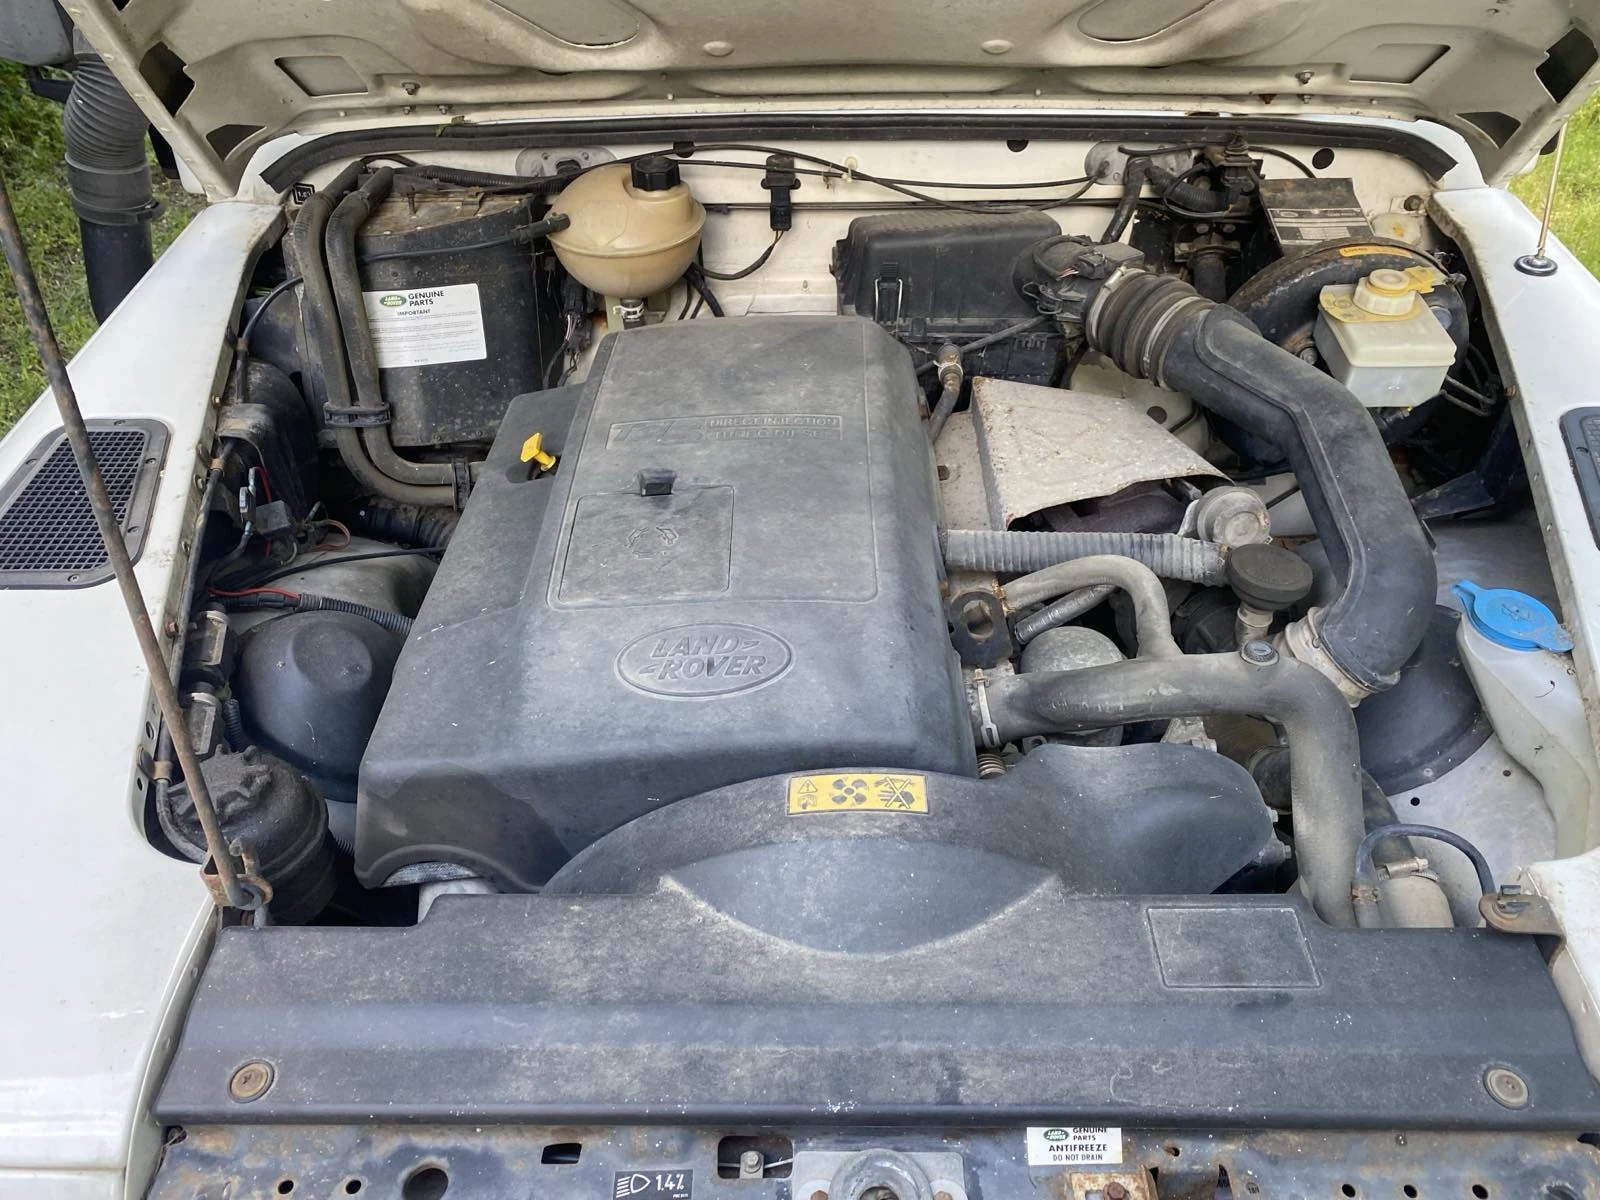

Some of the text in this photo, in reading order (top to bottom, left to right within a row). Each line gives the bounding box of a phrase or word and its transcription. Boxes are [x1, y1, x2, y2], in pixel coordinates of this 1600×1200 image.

[408, 290, 445, 300] GENUINE
[409, 299, 434, 307] PARTS
[651, 635, 740, 658] LAND
[657, 655, 767, 681] ROVER
[1048, 1144, 1108, 1152] ANTIFREEZE
[655, 1173, 684, 1191] 1.4%
